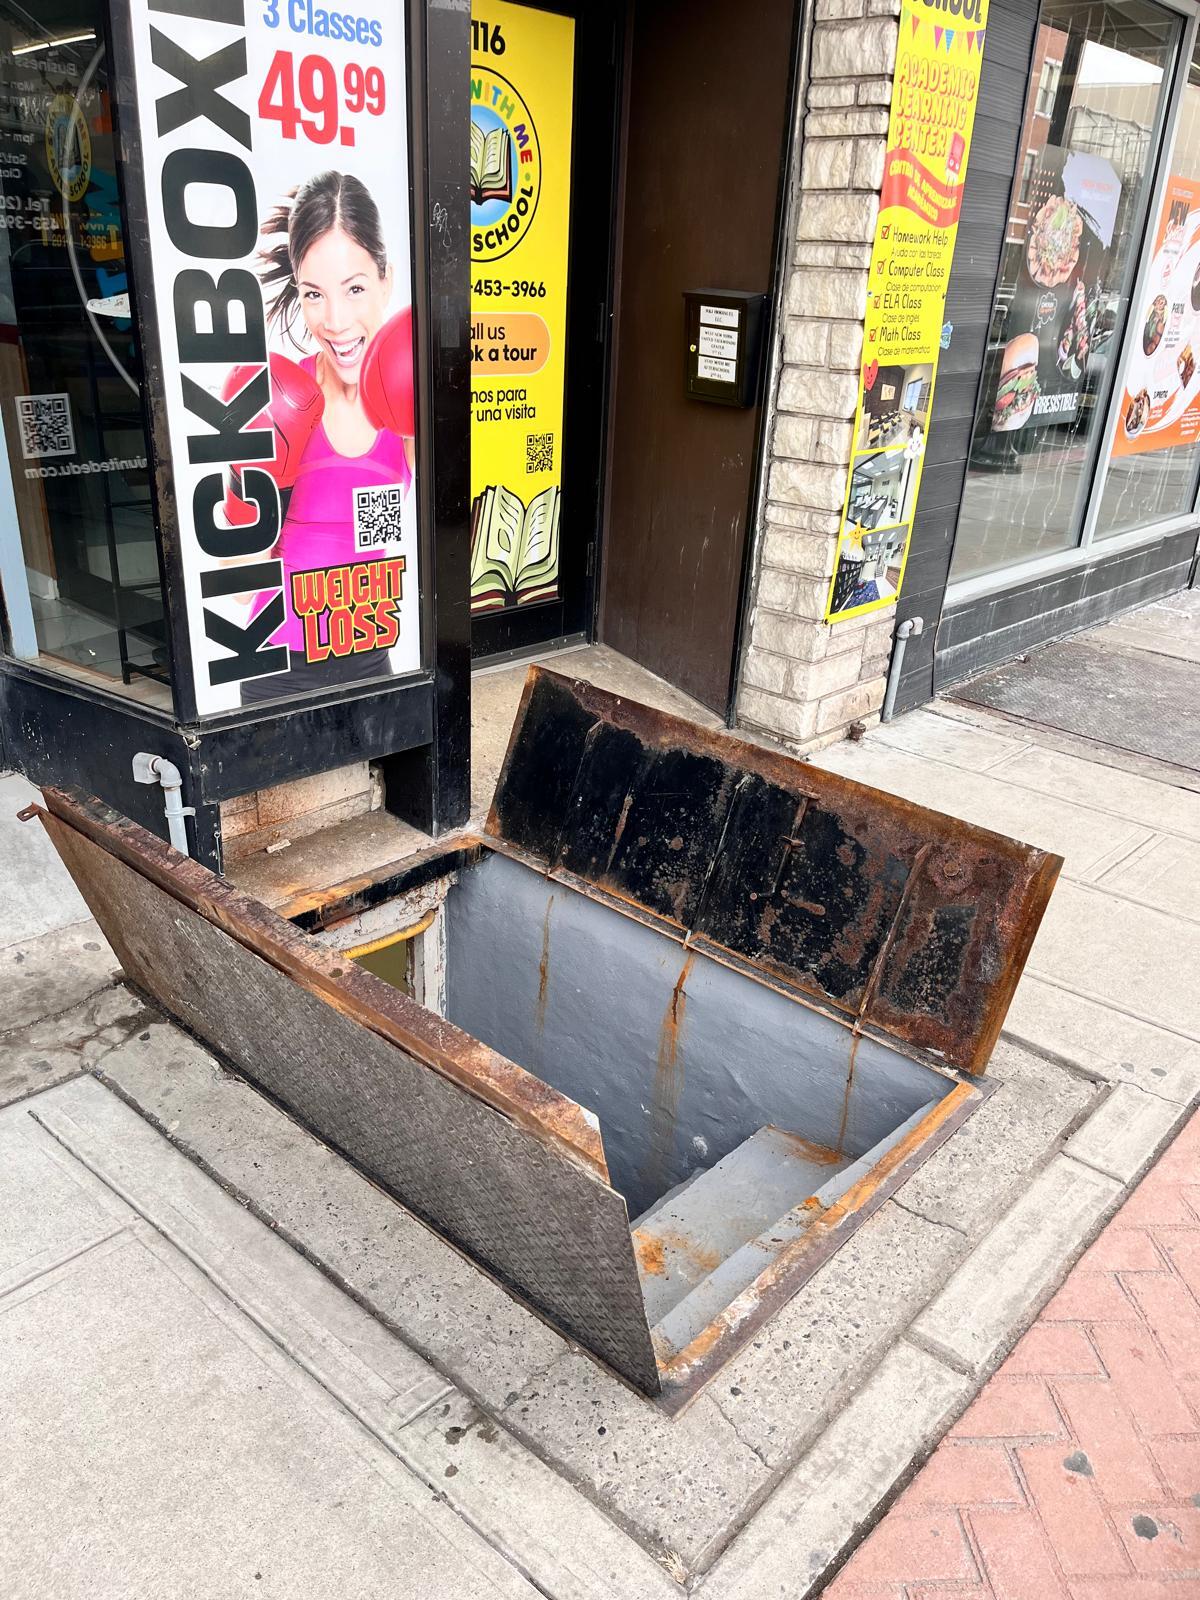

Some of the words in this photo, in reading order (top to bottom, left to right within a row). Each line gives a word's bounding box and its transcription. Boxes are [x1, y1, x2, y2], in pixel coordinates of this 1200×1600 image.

[263, 0, 280, 28] 3
[288, 0, 382, 47] Classes
[899, 52, 976, 102] ACADEMIC
[896, 83, 968, 131] LEARNING
[513, 123, 533, 164] ME
[893, 119, 948, 157] CENTER
[473, 185, 534, 252] SCHOOL
[893, 226, 931, 245] Homework
[932, 229, 949, 247] Help
[888, 260, 925, 279] Computer
[925, 261, 945, 278] Class
[883, 294, 900, 309] ELA
[901, 293, 922, 309] Class
[487, 326, 506, 340] us
[879, 326, 900, 342] Math
[901, 326, 921, 342] Class
[488, 351, 499, 361] a
[503, 344, 537, 361] tour
[497, 388, 527, 406] para
[1033, 392, 1079, 415] IRRESISTIBLE
[476, 409, 502, 422] una
[505, 403, 536, 420] visita
[291, 556, 406, 618] WEIGHT
[303, 599, 401, 664] LOSS
